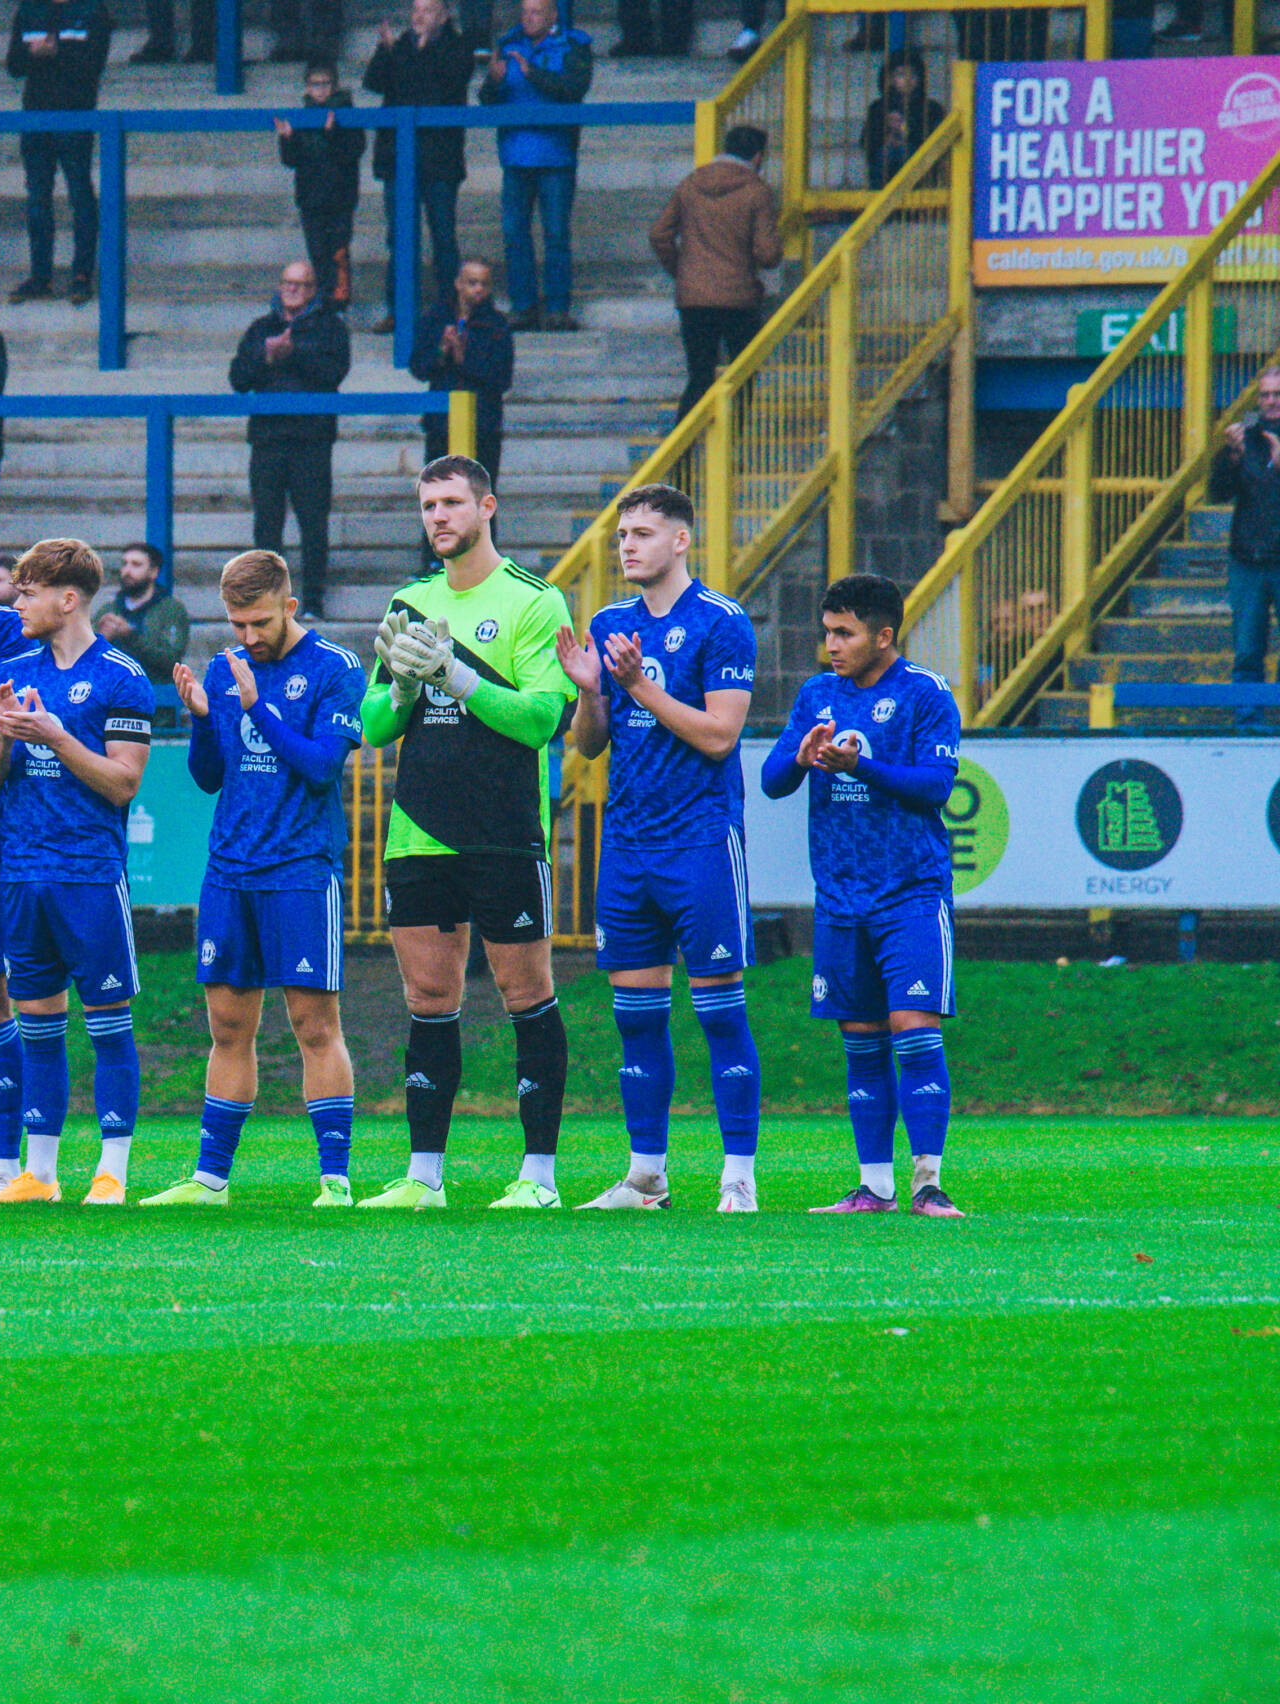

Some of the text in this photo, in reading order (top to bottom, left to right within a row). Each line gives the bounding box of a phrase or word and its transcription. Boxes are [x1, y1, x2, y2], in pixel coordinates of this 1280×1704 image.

[991, 75, 1114, 127] FOR A
[990, 127, 1206, 180] HEALTHIER
[989, 181, 1165, 232] HAPPIER
[424, 707, 459, 716] FACILITY
[111, 719, 144, 730] CAPTAIN
[423, 716, 460, 725] SERVICES
[26, 759, 60, 769] FACILITY
[241, 755, 277, 764] FACILITY
[239, 764, 278, 773] SERVICES
[831, 784, 868, 792] FACILITY
[831, 793, 870, 802] SERVICES
[1085, 876, 1172, 895] ENERGY
